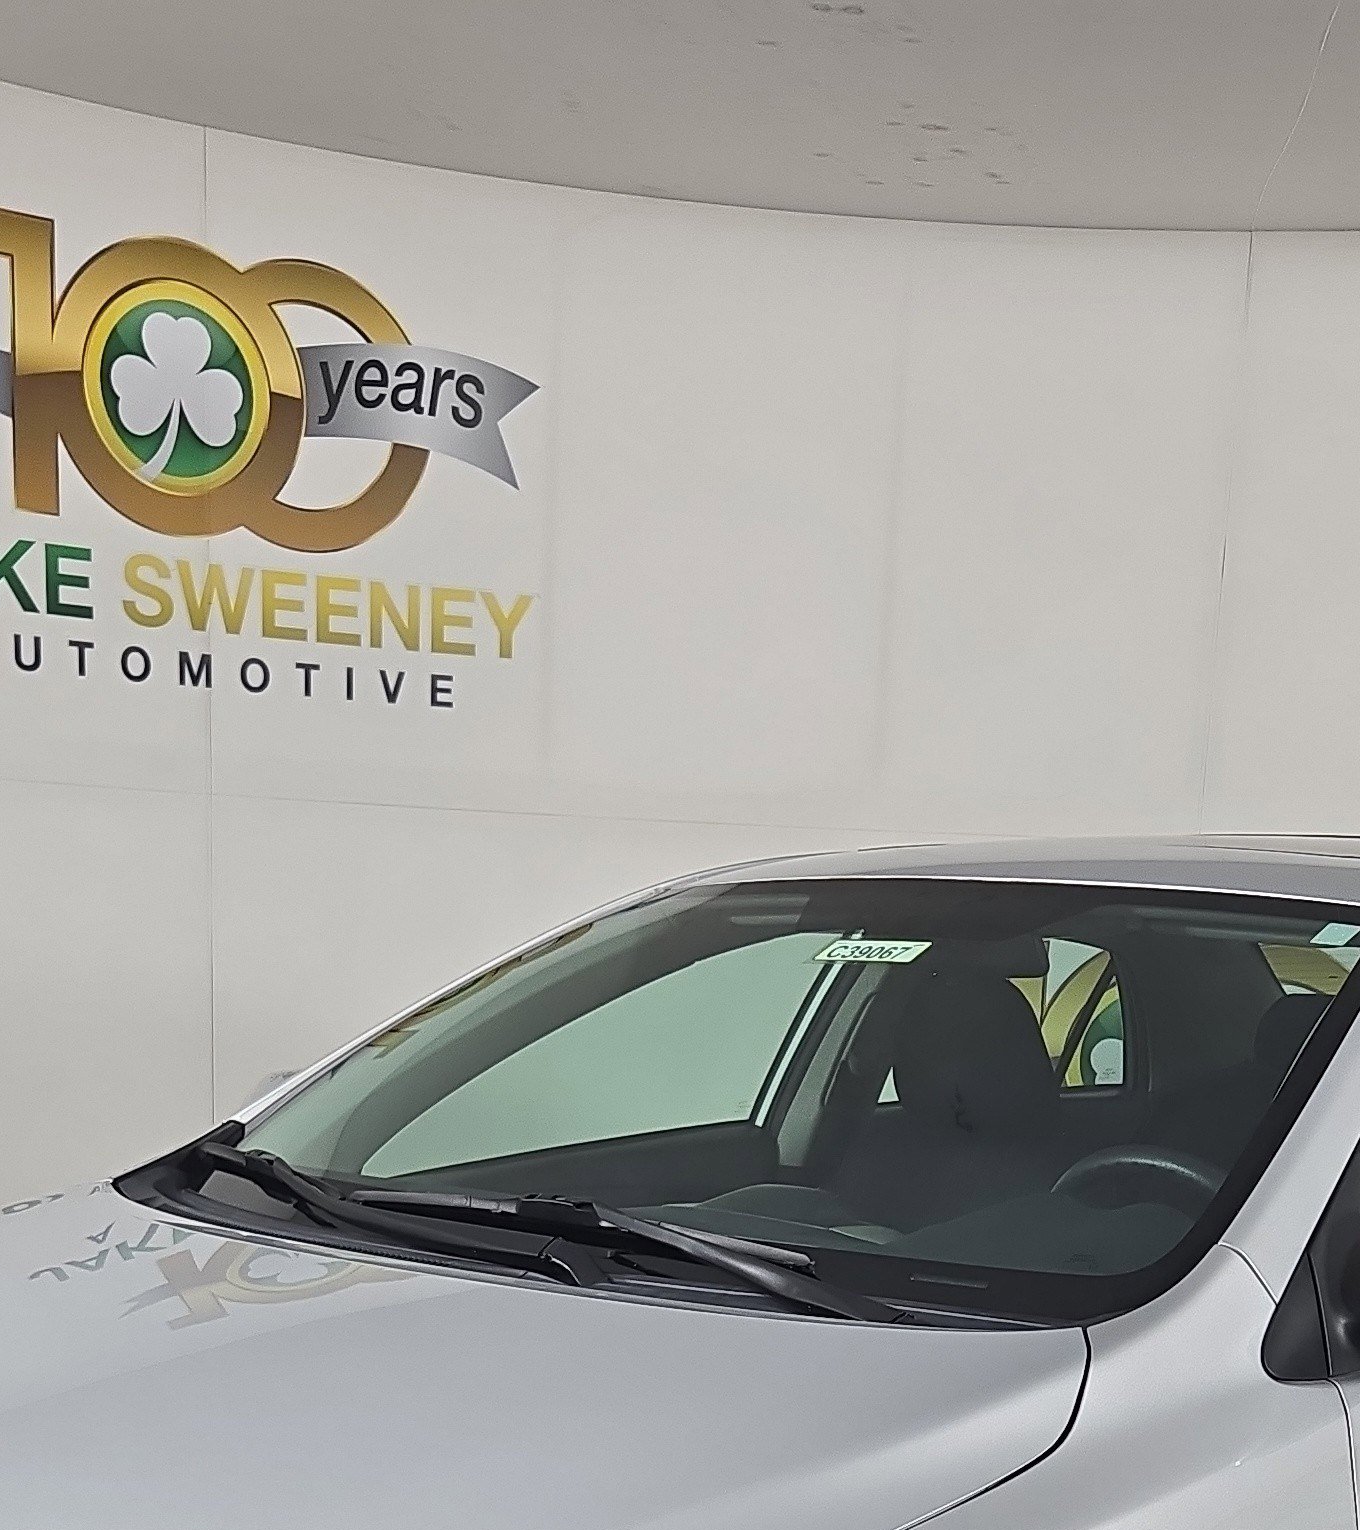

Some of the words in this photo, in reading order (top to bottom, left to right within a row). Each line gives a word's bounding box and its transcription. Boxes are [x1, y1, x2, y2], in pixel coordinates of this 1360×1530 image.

[318, 359, 486, 428] years
[121, 552, 535, 660] SWEENEY
[826, 945, 914, 960] C39067
